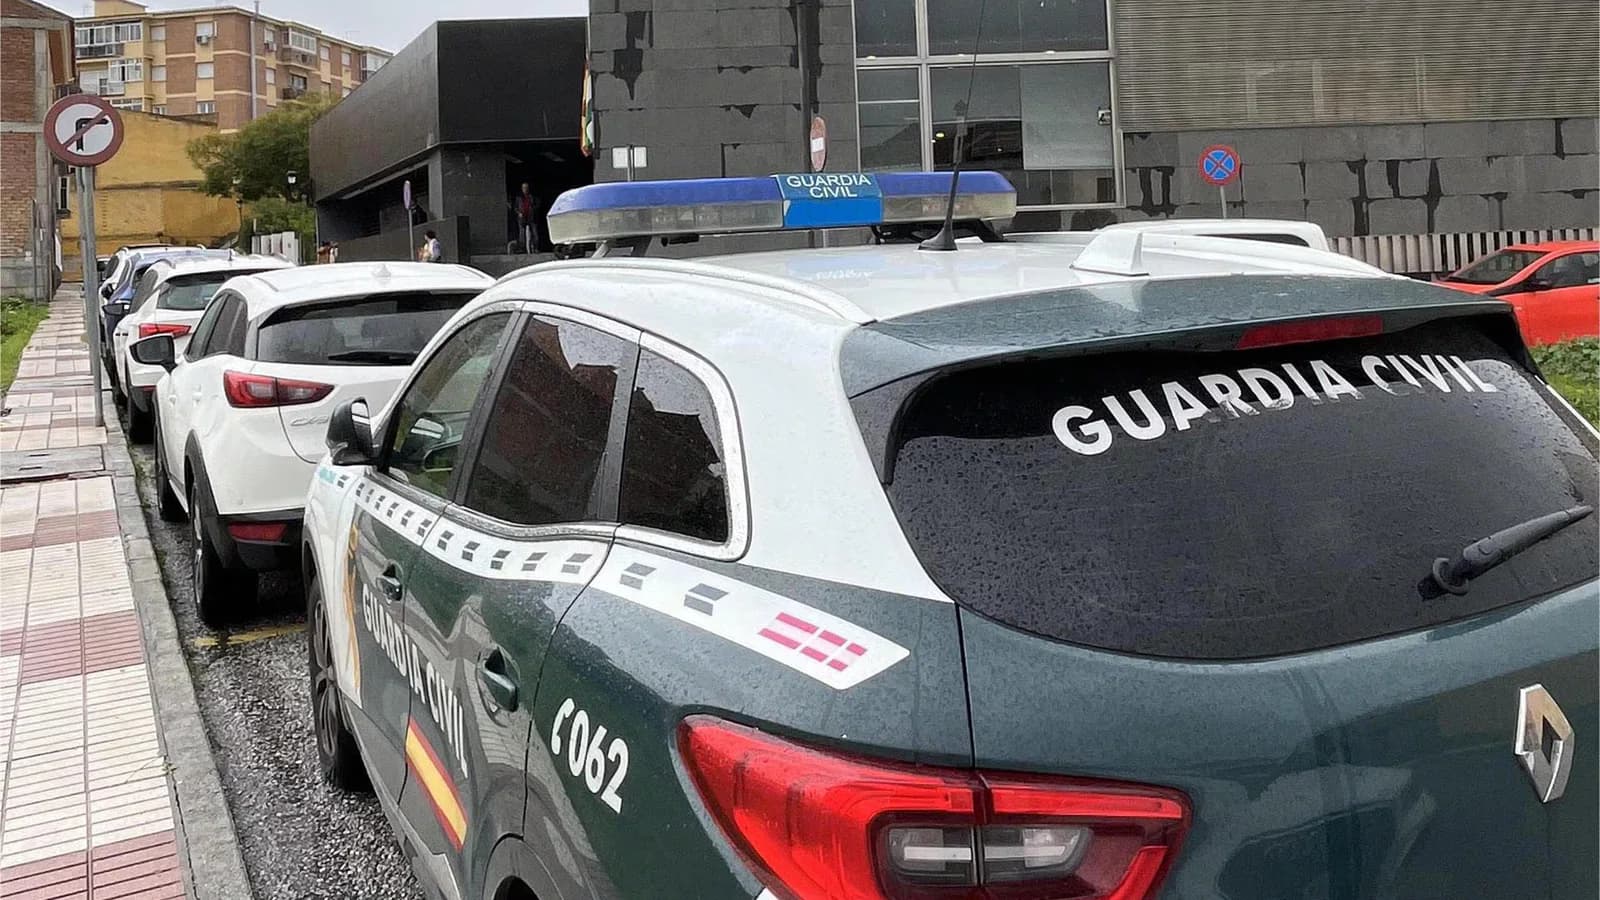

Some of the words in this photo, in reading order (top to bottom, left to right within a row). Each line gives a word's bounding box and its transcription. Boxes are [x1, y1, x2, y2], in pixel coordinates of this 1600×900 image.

[787, 174, 871, 187] GUARDIA
[810, 187, 858, 198] CIVIL
[1051, 360, 1362, 456] GUARDIA
[1361, 354, 1498, 395] CIVIL
[363, 583, 426, 704] GUARDIA
[426, 661, 468, 778] CIVIL
[568, 709, 629, 814] 062
